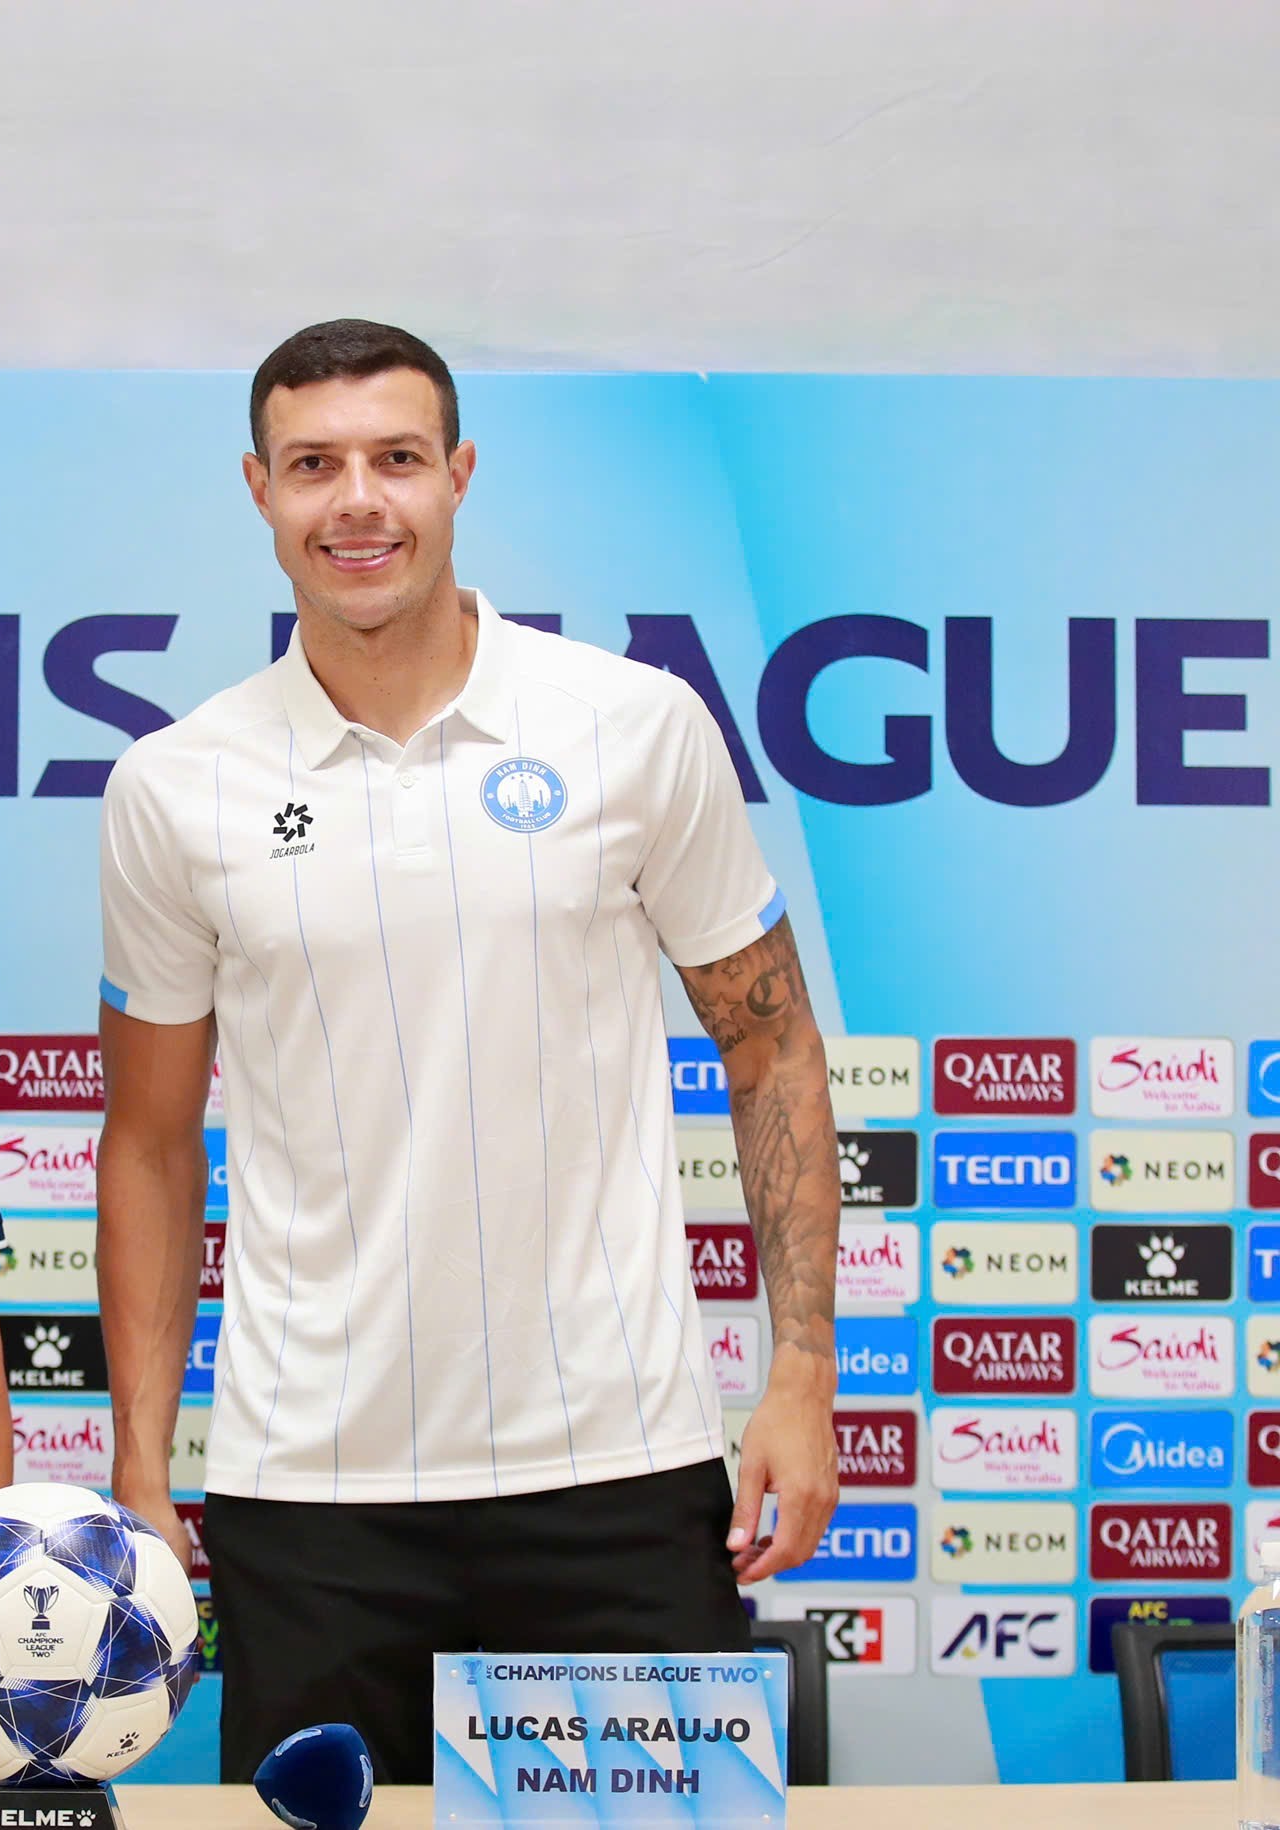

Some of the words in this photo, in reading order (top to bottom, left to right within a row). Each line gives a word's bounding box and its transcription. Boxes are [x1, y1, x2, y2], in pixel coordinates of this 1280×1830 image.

[495, 762, 517, 777] NAM
[522, 762, 547, 775] DINH
[269, 843, 315, 859] JOGARBOLA
[829, 1068, 910, 1085] NEOM
[944, 1053, 1062, 1088] QATAR
[974, 1082, 1064, 1102] AIRWAYS
[940, 1156, 1070, 1185] TECNO
[1145, 1161, 1225, 1180] NEOM
[841, 1185, 883, 1202] LME
[30, 1250, 97, 1269] NEO
[686, 1238, 745, 1268] TAR
[987, 1254, 1067, 1273] NEOM
[1125, 1279, 1199, 1297] KELME
[943, 1331, 1062, 1368] QATAR
[836, 1347, 909, 1374] idea
[9, 1370, 84, 1386] KELME
[973, 1362, 1064, 1382] AIRWAYS
[836, 1425, 904, 1454] TAR
[985, 1532, 1066, 1551] NEOM
[1100, 1517, 1218, 1554] QATAR
[1131, 1549, 1219, 1567] AIRWAYS
[1128, 1601, 1168, 1620] AFC
[940, 1613, 1058, 1658] AFC
[494, 1664, 618, 1681] CHAMPIONS
[623, 1666, 702, 1683] LEAGUE
[707, 1667, 758, 1683] TWO
[468, 1715, 588, 1741] LUCAS
[600, 1717, 751, 1743] ARAUJO
[517, 1768, 596, 1793] NAM
[611, 1769, 699, 1794] DINH
